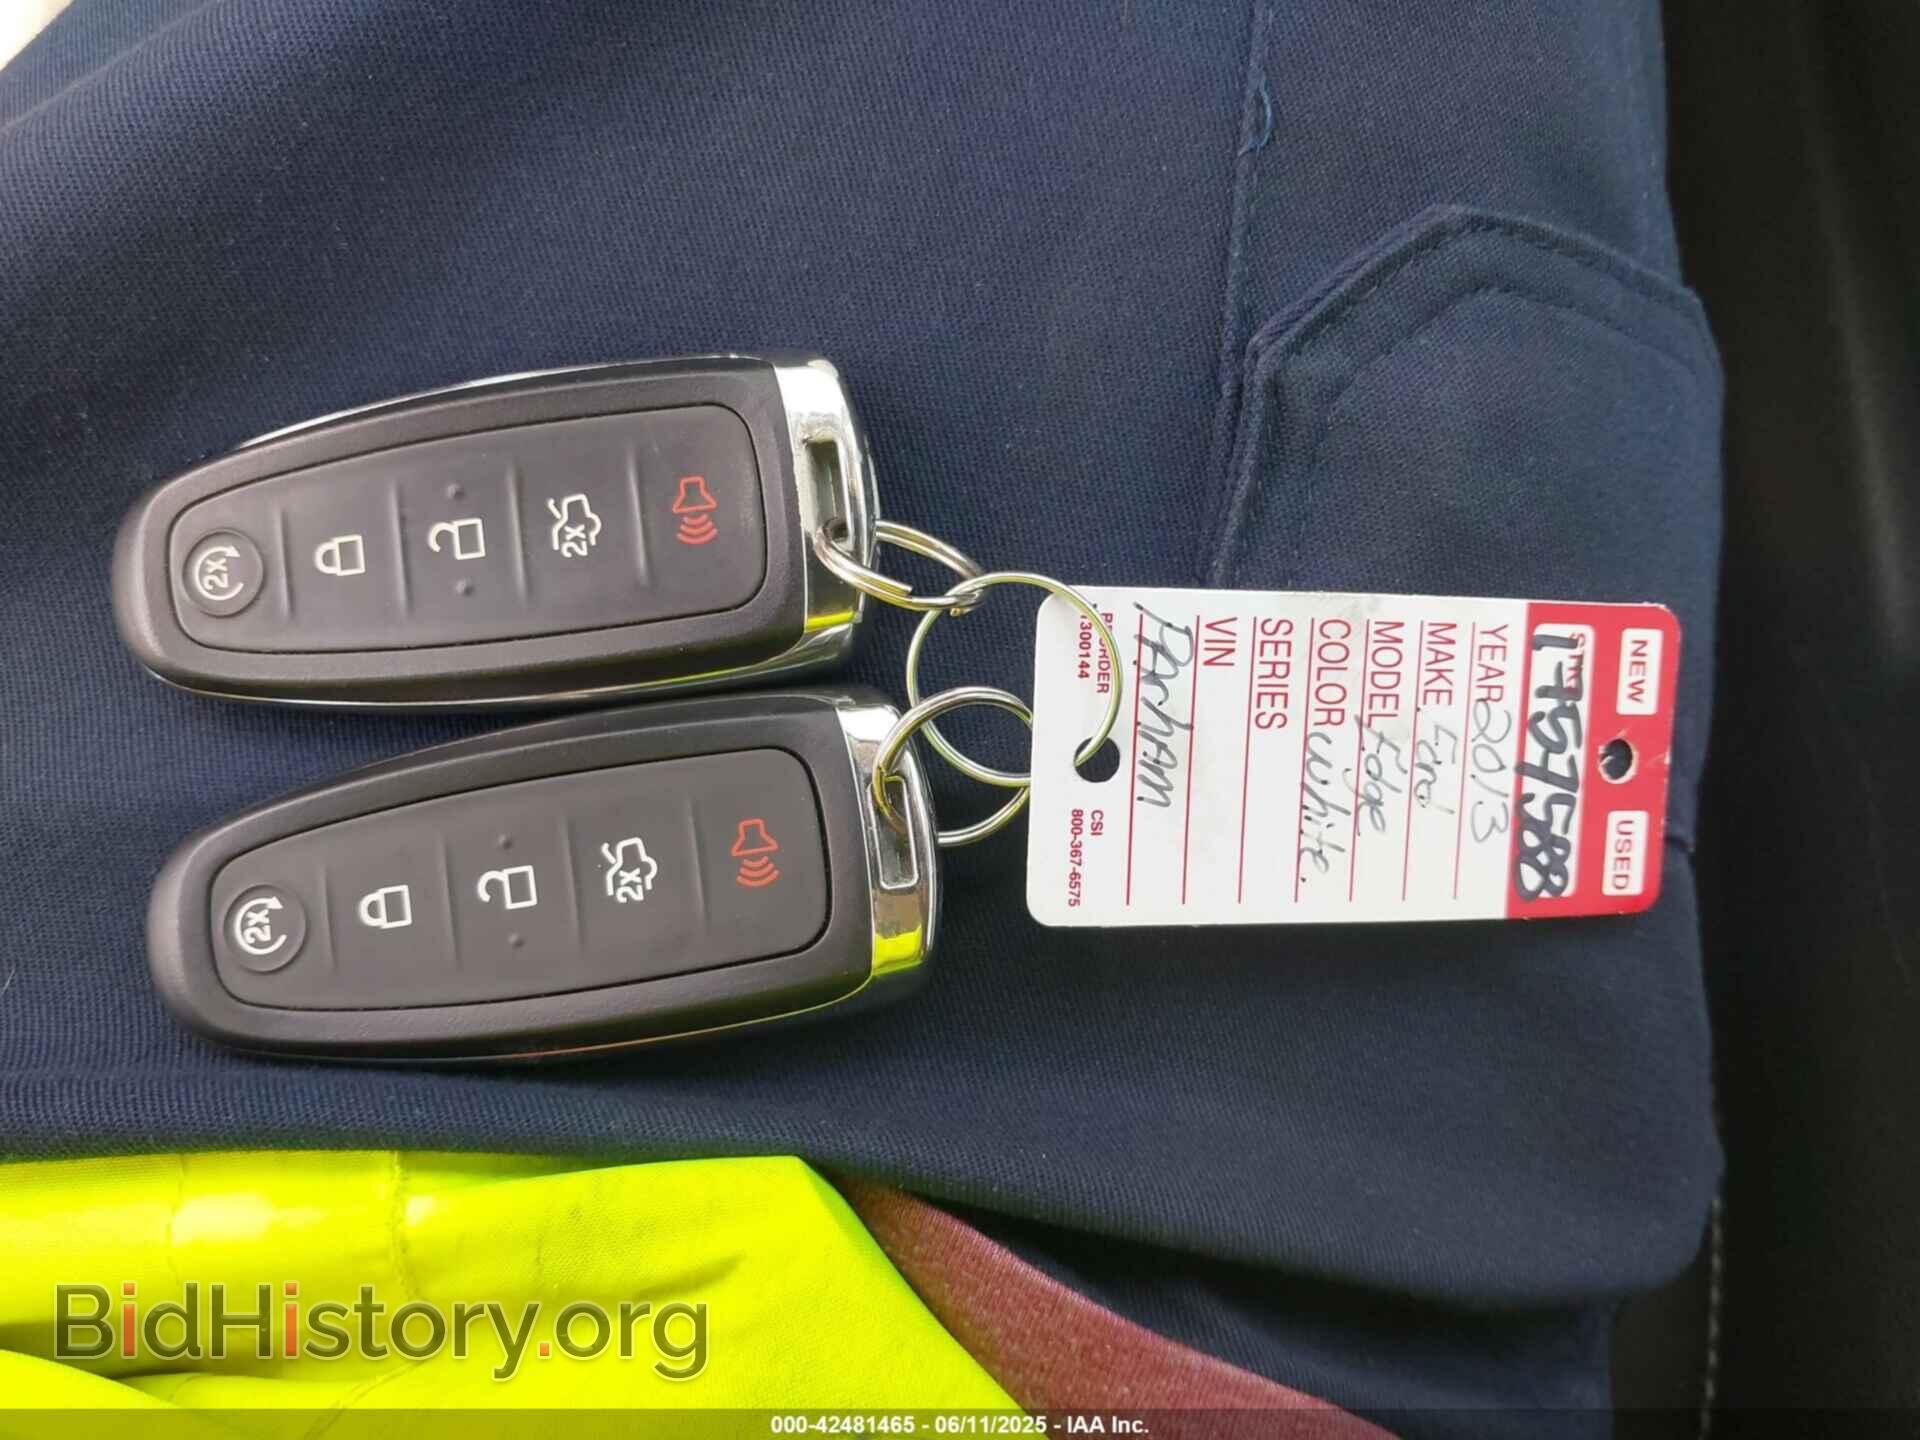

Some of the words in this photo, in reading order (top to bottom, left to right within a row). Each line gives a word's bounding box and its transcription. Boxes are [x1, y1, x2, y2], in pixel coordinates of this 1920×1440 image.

[1096, 612, 1114, 694] RRDER
[1202, 616, 1238, 667] VIN
[1254, 618, 1293, 730] SERIES
[1314, 618, 1351, 728] COLOR
[1368, 620, 1405, 728] MODEL
[1422, 622, 1457, 706] MAKE
[1475, 623, 1508, 703] YEAR
[1627, 638, 1649, 705] NEW
[1470, 698, 1512, 843] 2013
[1068, 808, 1084, 908] 800-367-6575
[1089, 809, 1104, 837] CSI
[1613, 818, 1634, 891] USED
